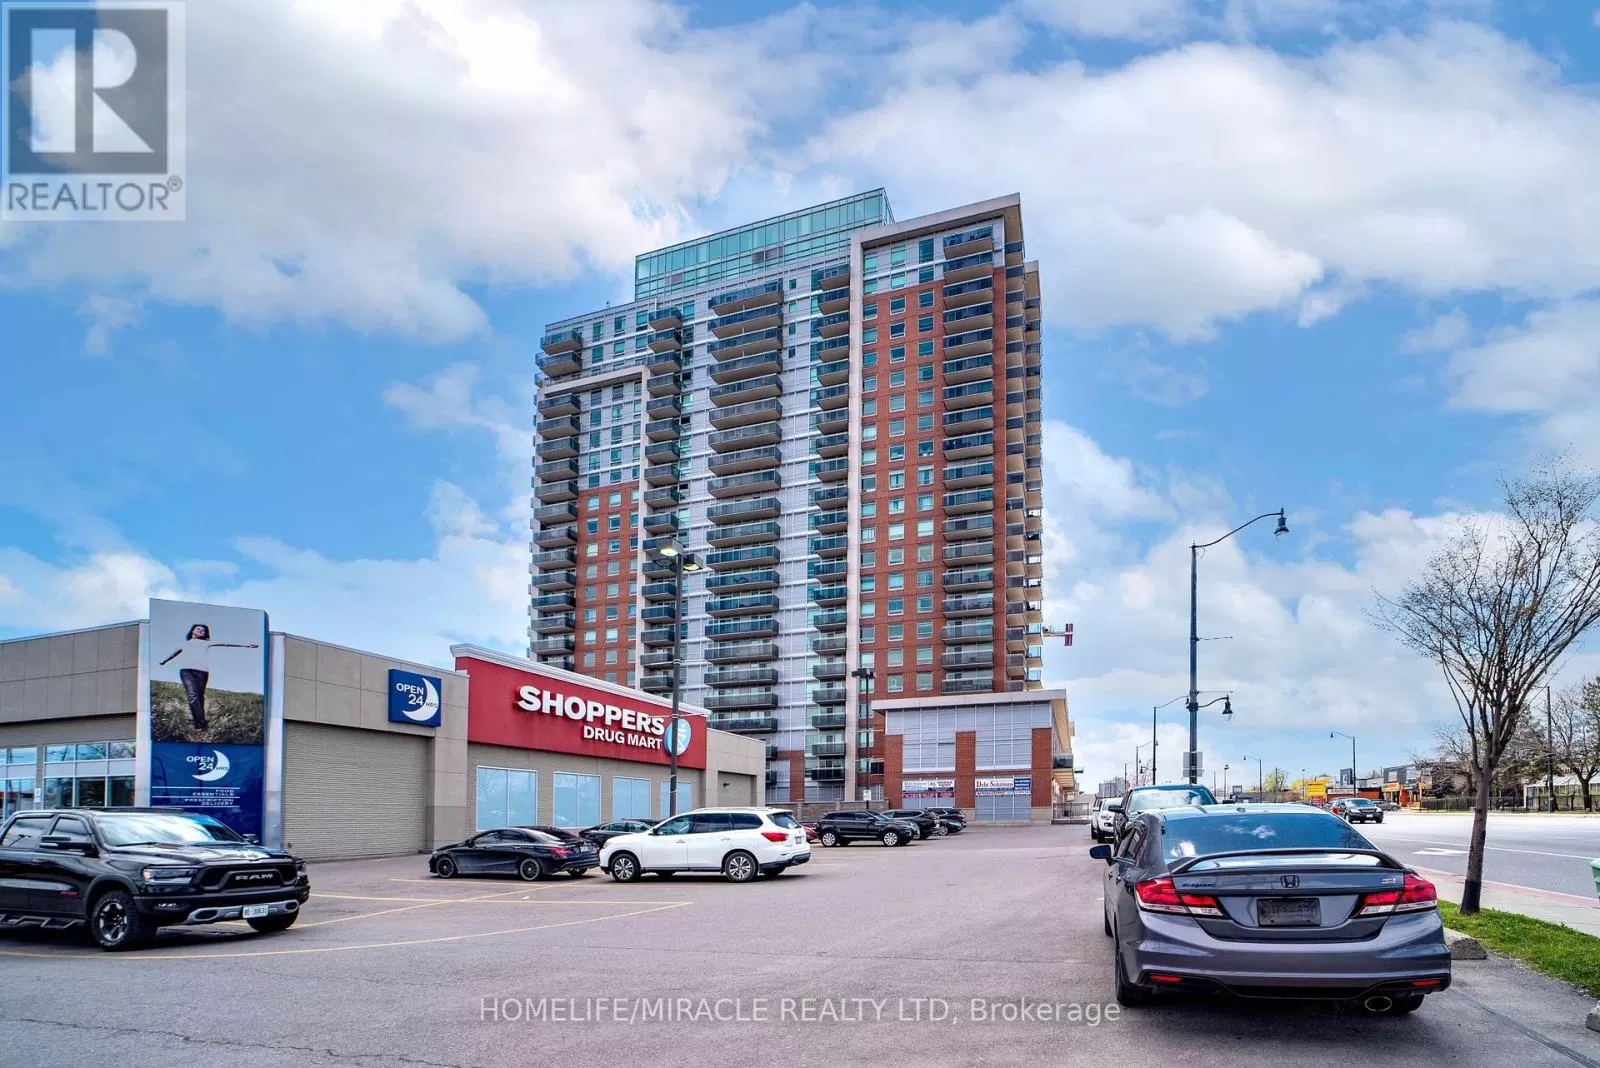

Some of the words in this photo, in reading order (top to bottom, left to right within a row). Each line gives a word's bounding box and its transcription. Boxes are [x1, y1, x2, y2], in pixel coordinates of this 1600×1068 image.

[396, 682, 424, 695] OPEN
[408, 693, 424, 706] 24
[517, 685, 665, 735] SHOPPERS
[583, 725, 625, 746] DRUG
[627, 733, 662, 750] MART
[186, 755, 215, 763] OPEN
[199, 762, 214, 771] 24
